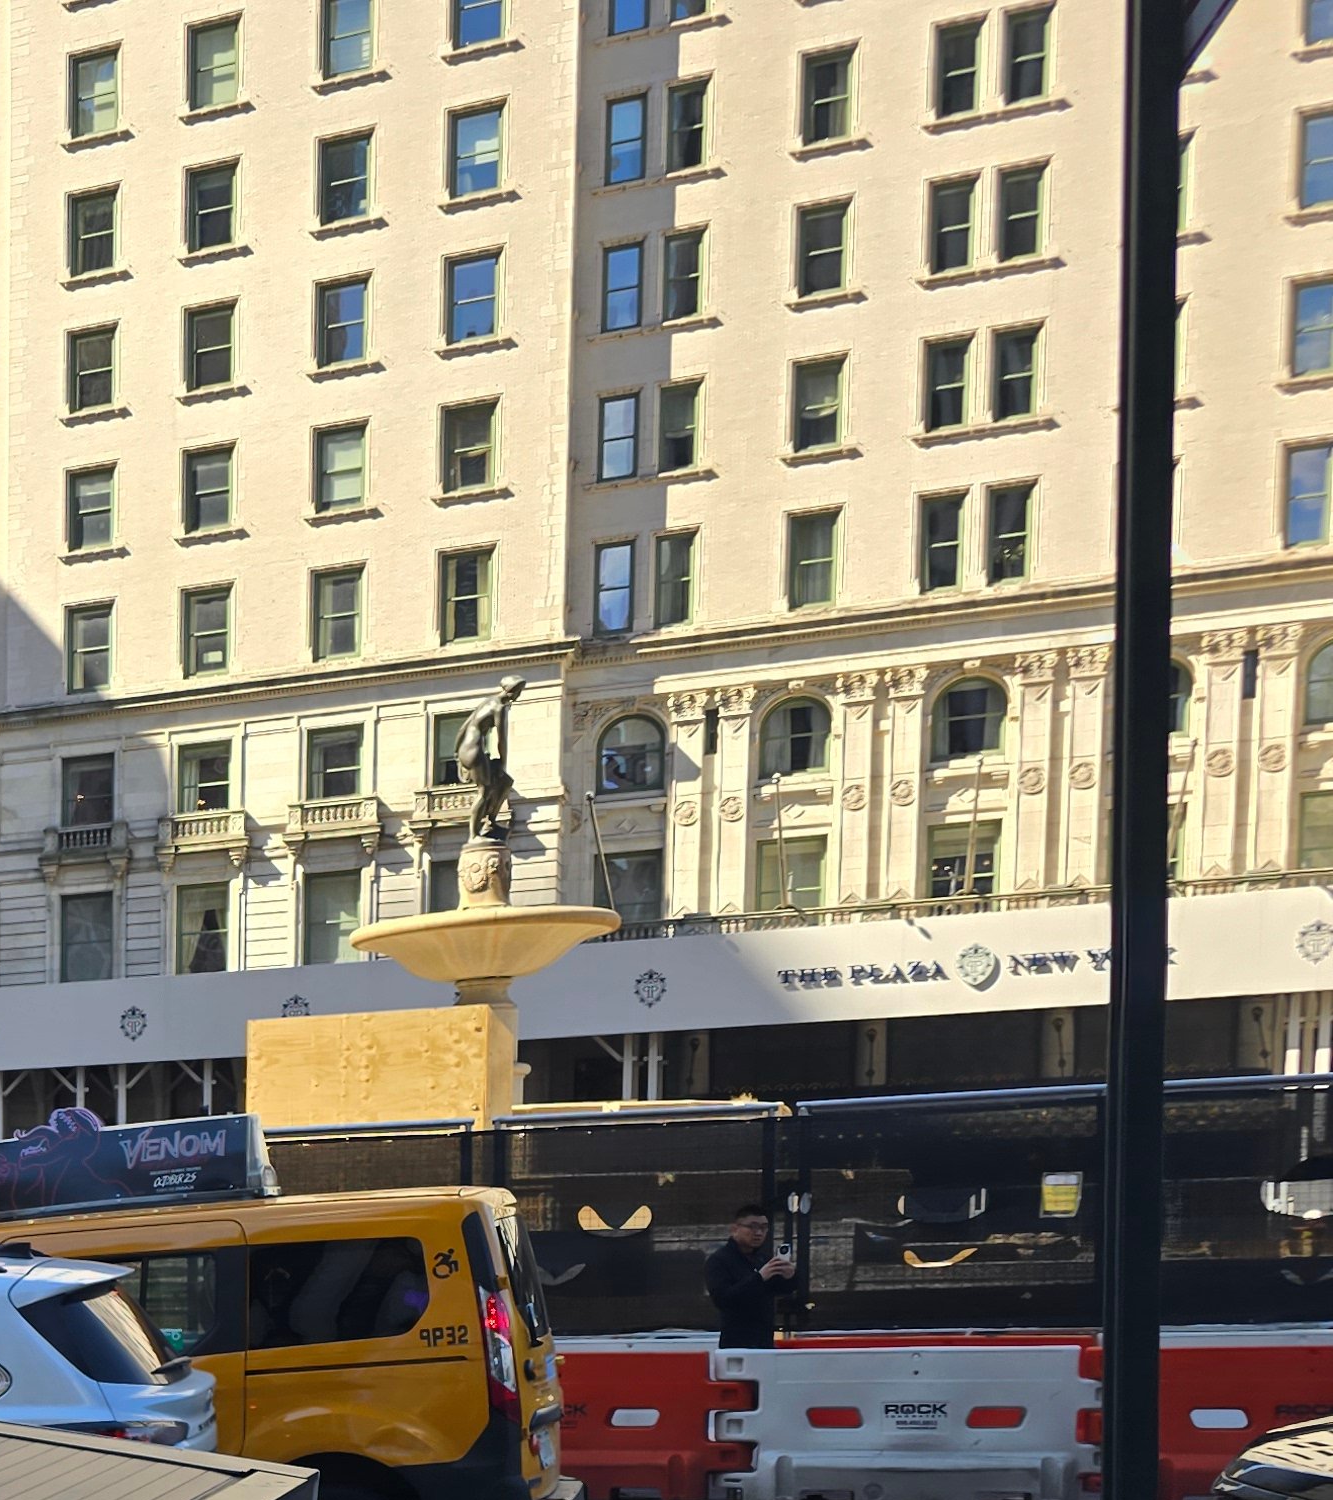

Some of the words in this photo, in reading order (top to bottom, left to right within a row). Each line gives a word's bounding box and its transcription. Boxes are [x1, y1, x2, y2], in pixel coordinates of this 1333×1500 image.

[777, 967, 841, 984] THE
[847, 960, 947, 982] PLAZA
[1006, 953, 1079, 974] NEW
[119, 1126, 227, 1169] VENOM
[419, 1325, 469, 1348] 9P32
[884, 1403, 948, 1415] ROCK
